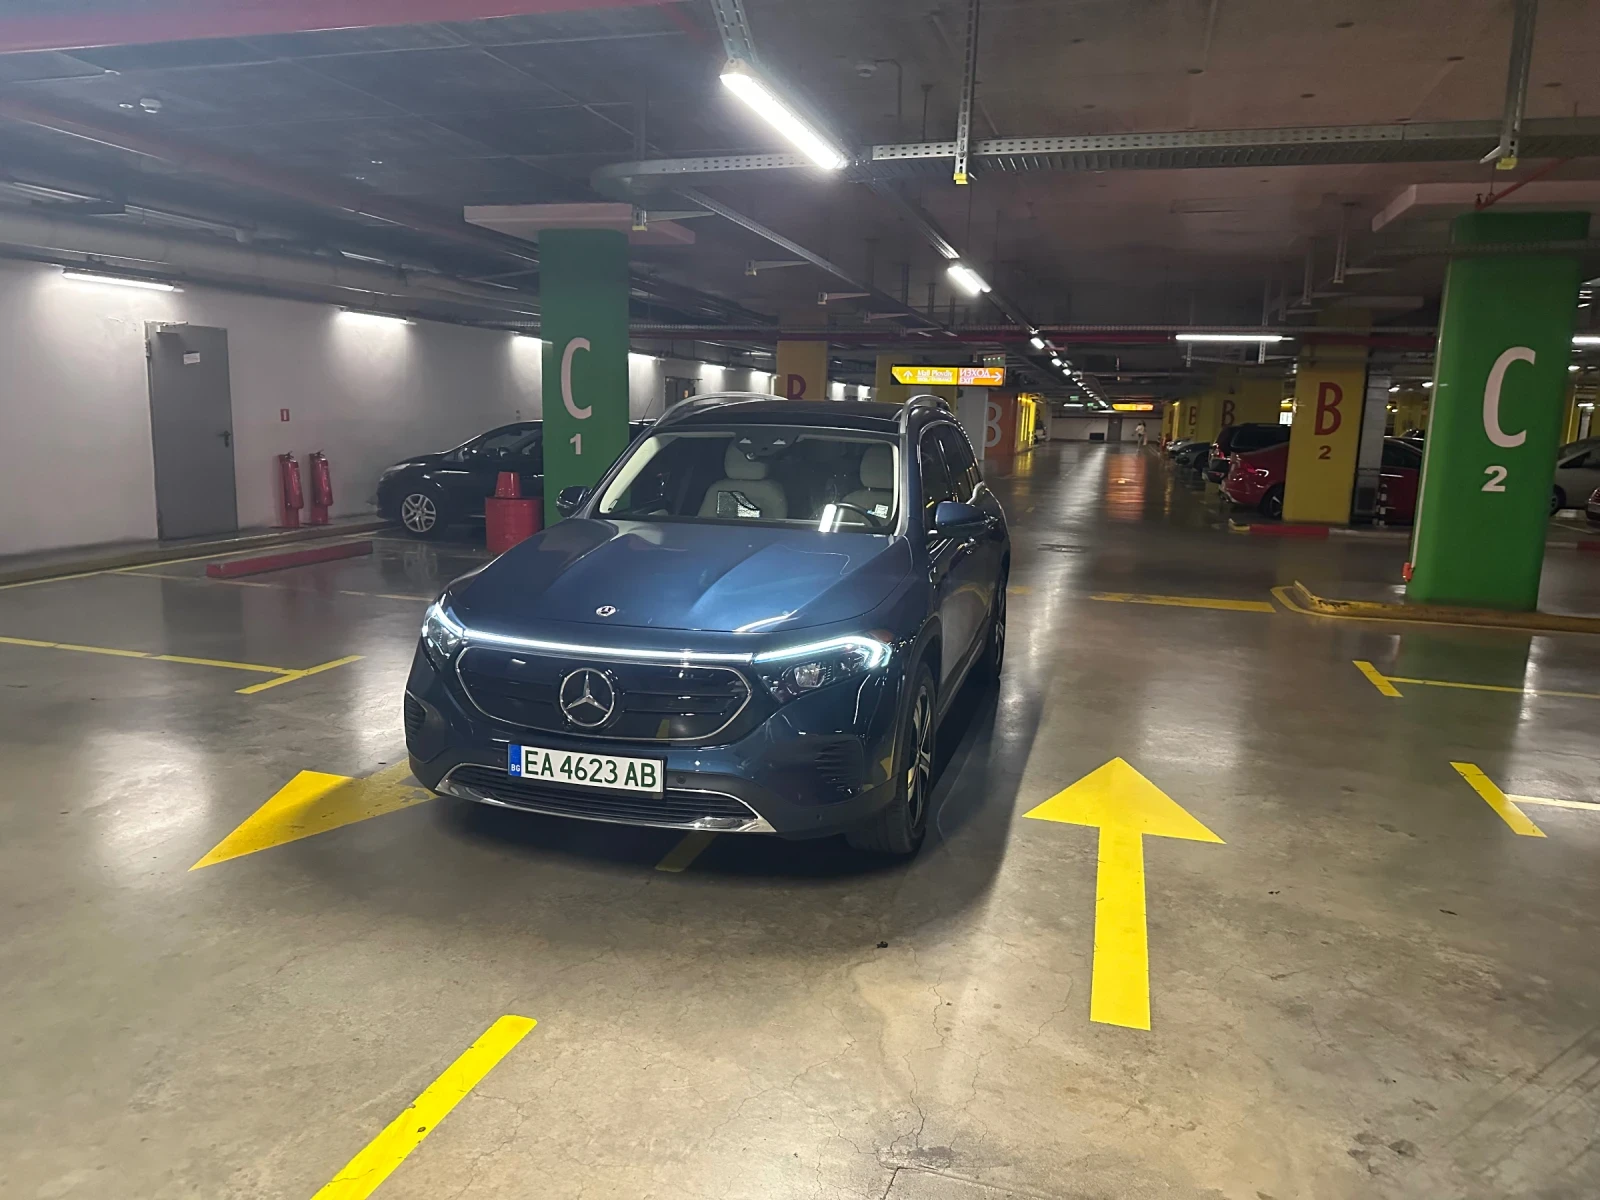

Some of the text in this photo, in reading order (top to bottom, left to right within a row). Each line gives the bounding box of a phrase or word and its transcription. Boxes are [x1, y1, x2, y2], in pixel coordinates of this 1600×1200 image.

[561, 337, 592, 420] C
[960, 368, 990, 378] ИЗХОД
[1314, 382, 1343, 435] B
[1482, 346, 1536, 448] C
[984, 402, 1002, 447] B
[1221, 400, 1235, 427] B
[570, 433, 582, 455] 1
[1318, 445, 1332, 460] 2
[1481, 465, 1508, 492] 2
[511, 763, 521, 772] BG
[524, 749, 656, 788] EA 4623 AB
